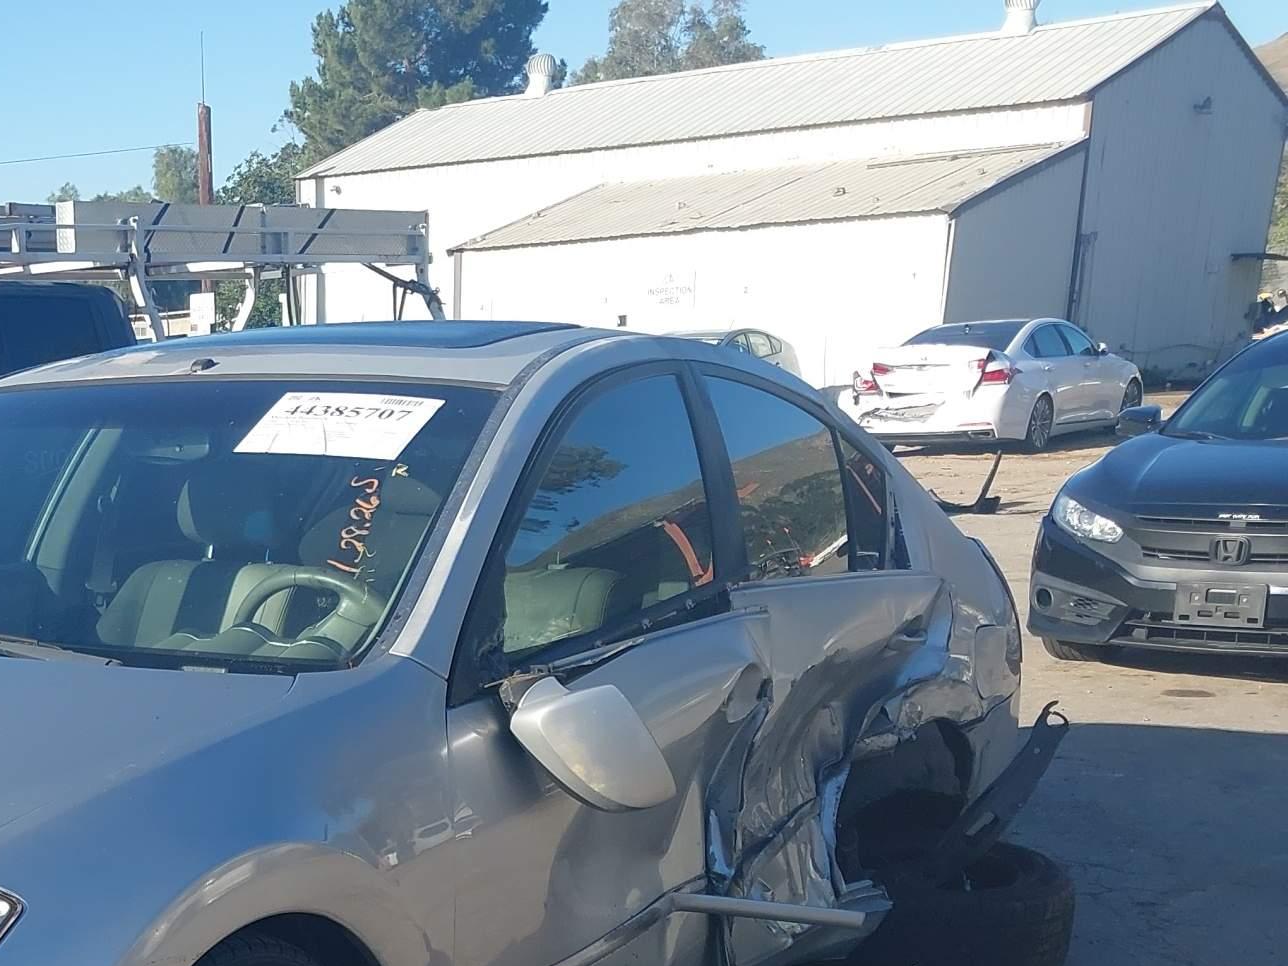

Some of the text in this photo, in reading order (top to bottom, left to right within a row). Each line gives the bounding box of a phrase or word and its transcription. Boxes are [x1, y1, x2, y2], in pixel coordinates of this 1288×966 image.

[647, 285, 692, 297] INSPECTION
[658, 296, 680, 305] AREA
[284, 403, 414, 422] 44385707
